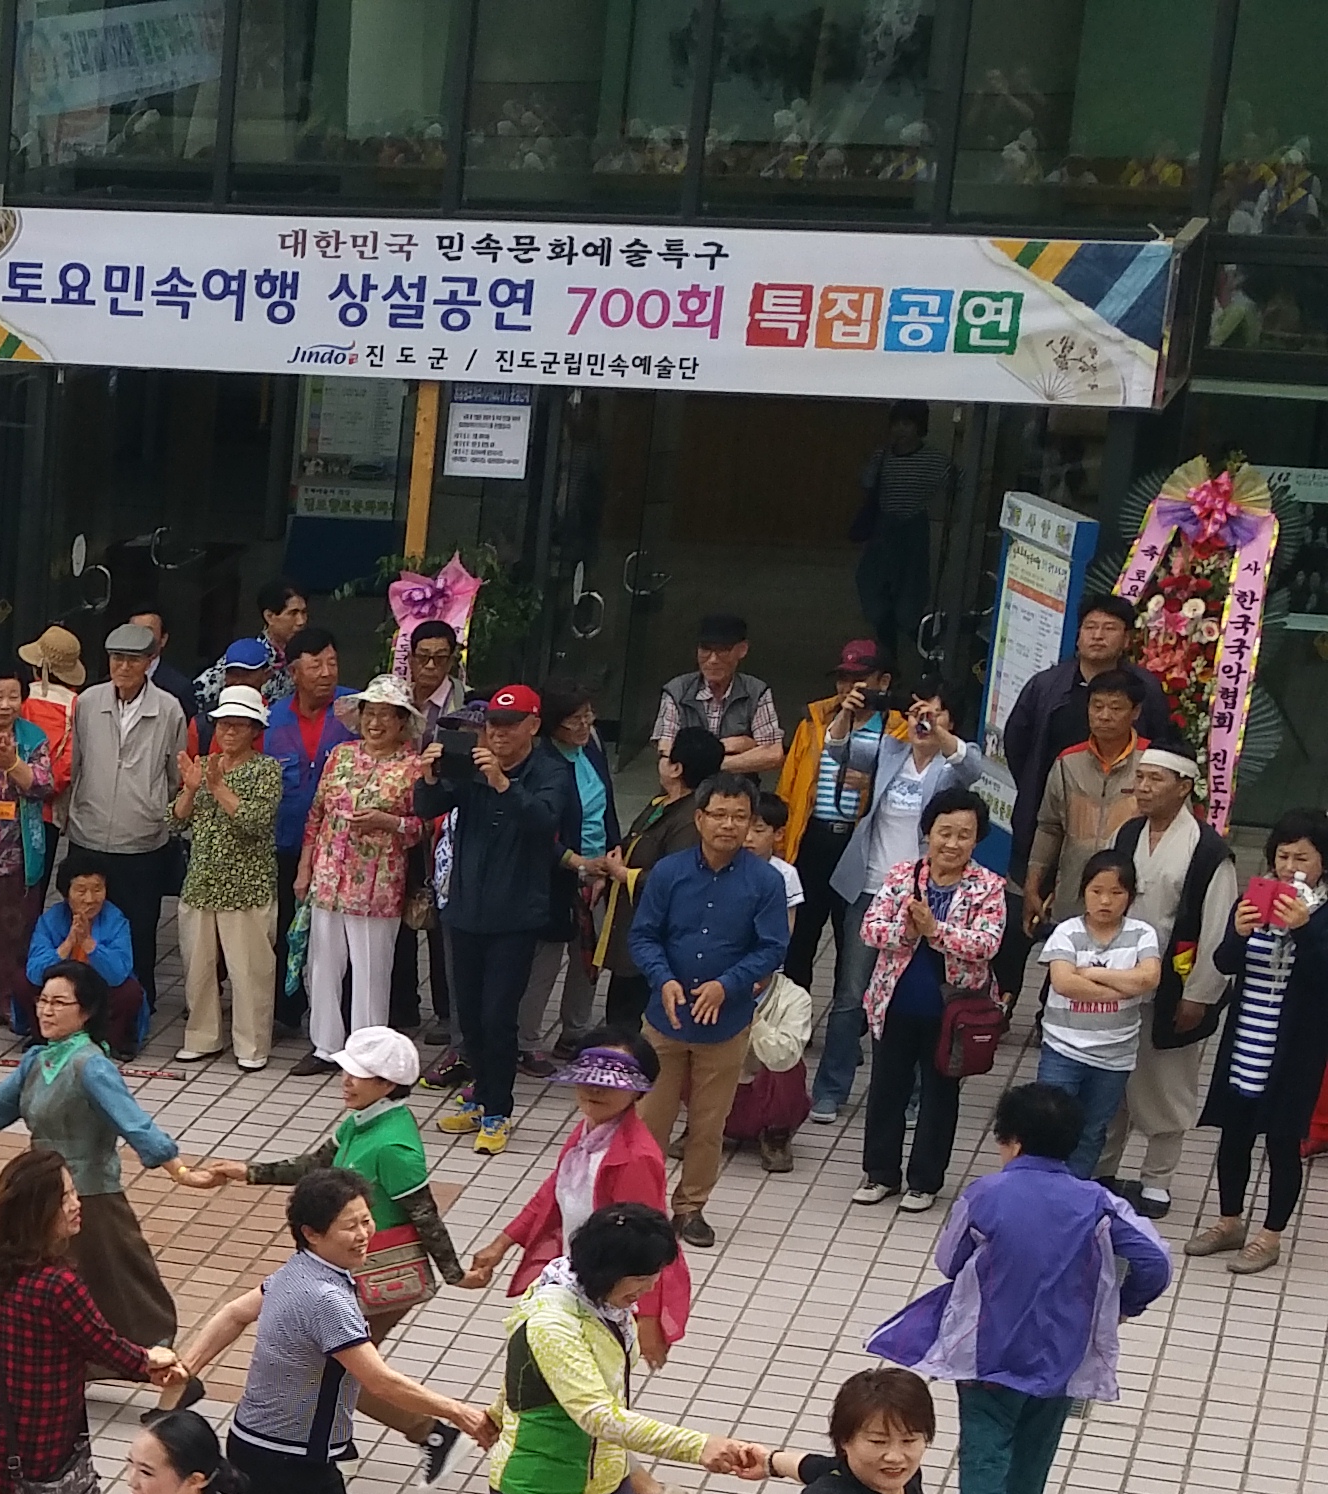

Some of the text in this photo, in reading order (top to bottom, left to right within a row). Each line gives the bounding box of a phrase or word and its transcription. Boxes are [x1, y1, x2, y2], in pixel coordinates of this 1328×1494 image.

[278, 228, 730, 271] 대한민국 민속문화예술특구
[1, 260, 1013, 350] 토요민속여행 상설공연 700회 특집공연
[365, 345, 450, 372] 진도군
[495, 349, 701, 381] 진도군립민속예술단
[1212, 589, 1260, 735] 한국국악협회
